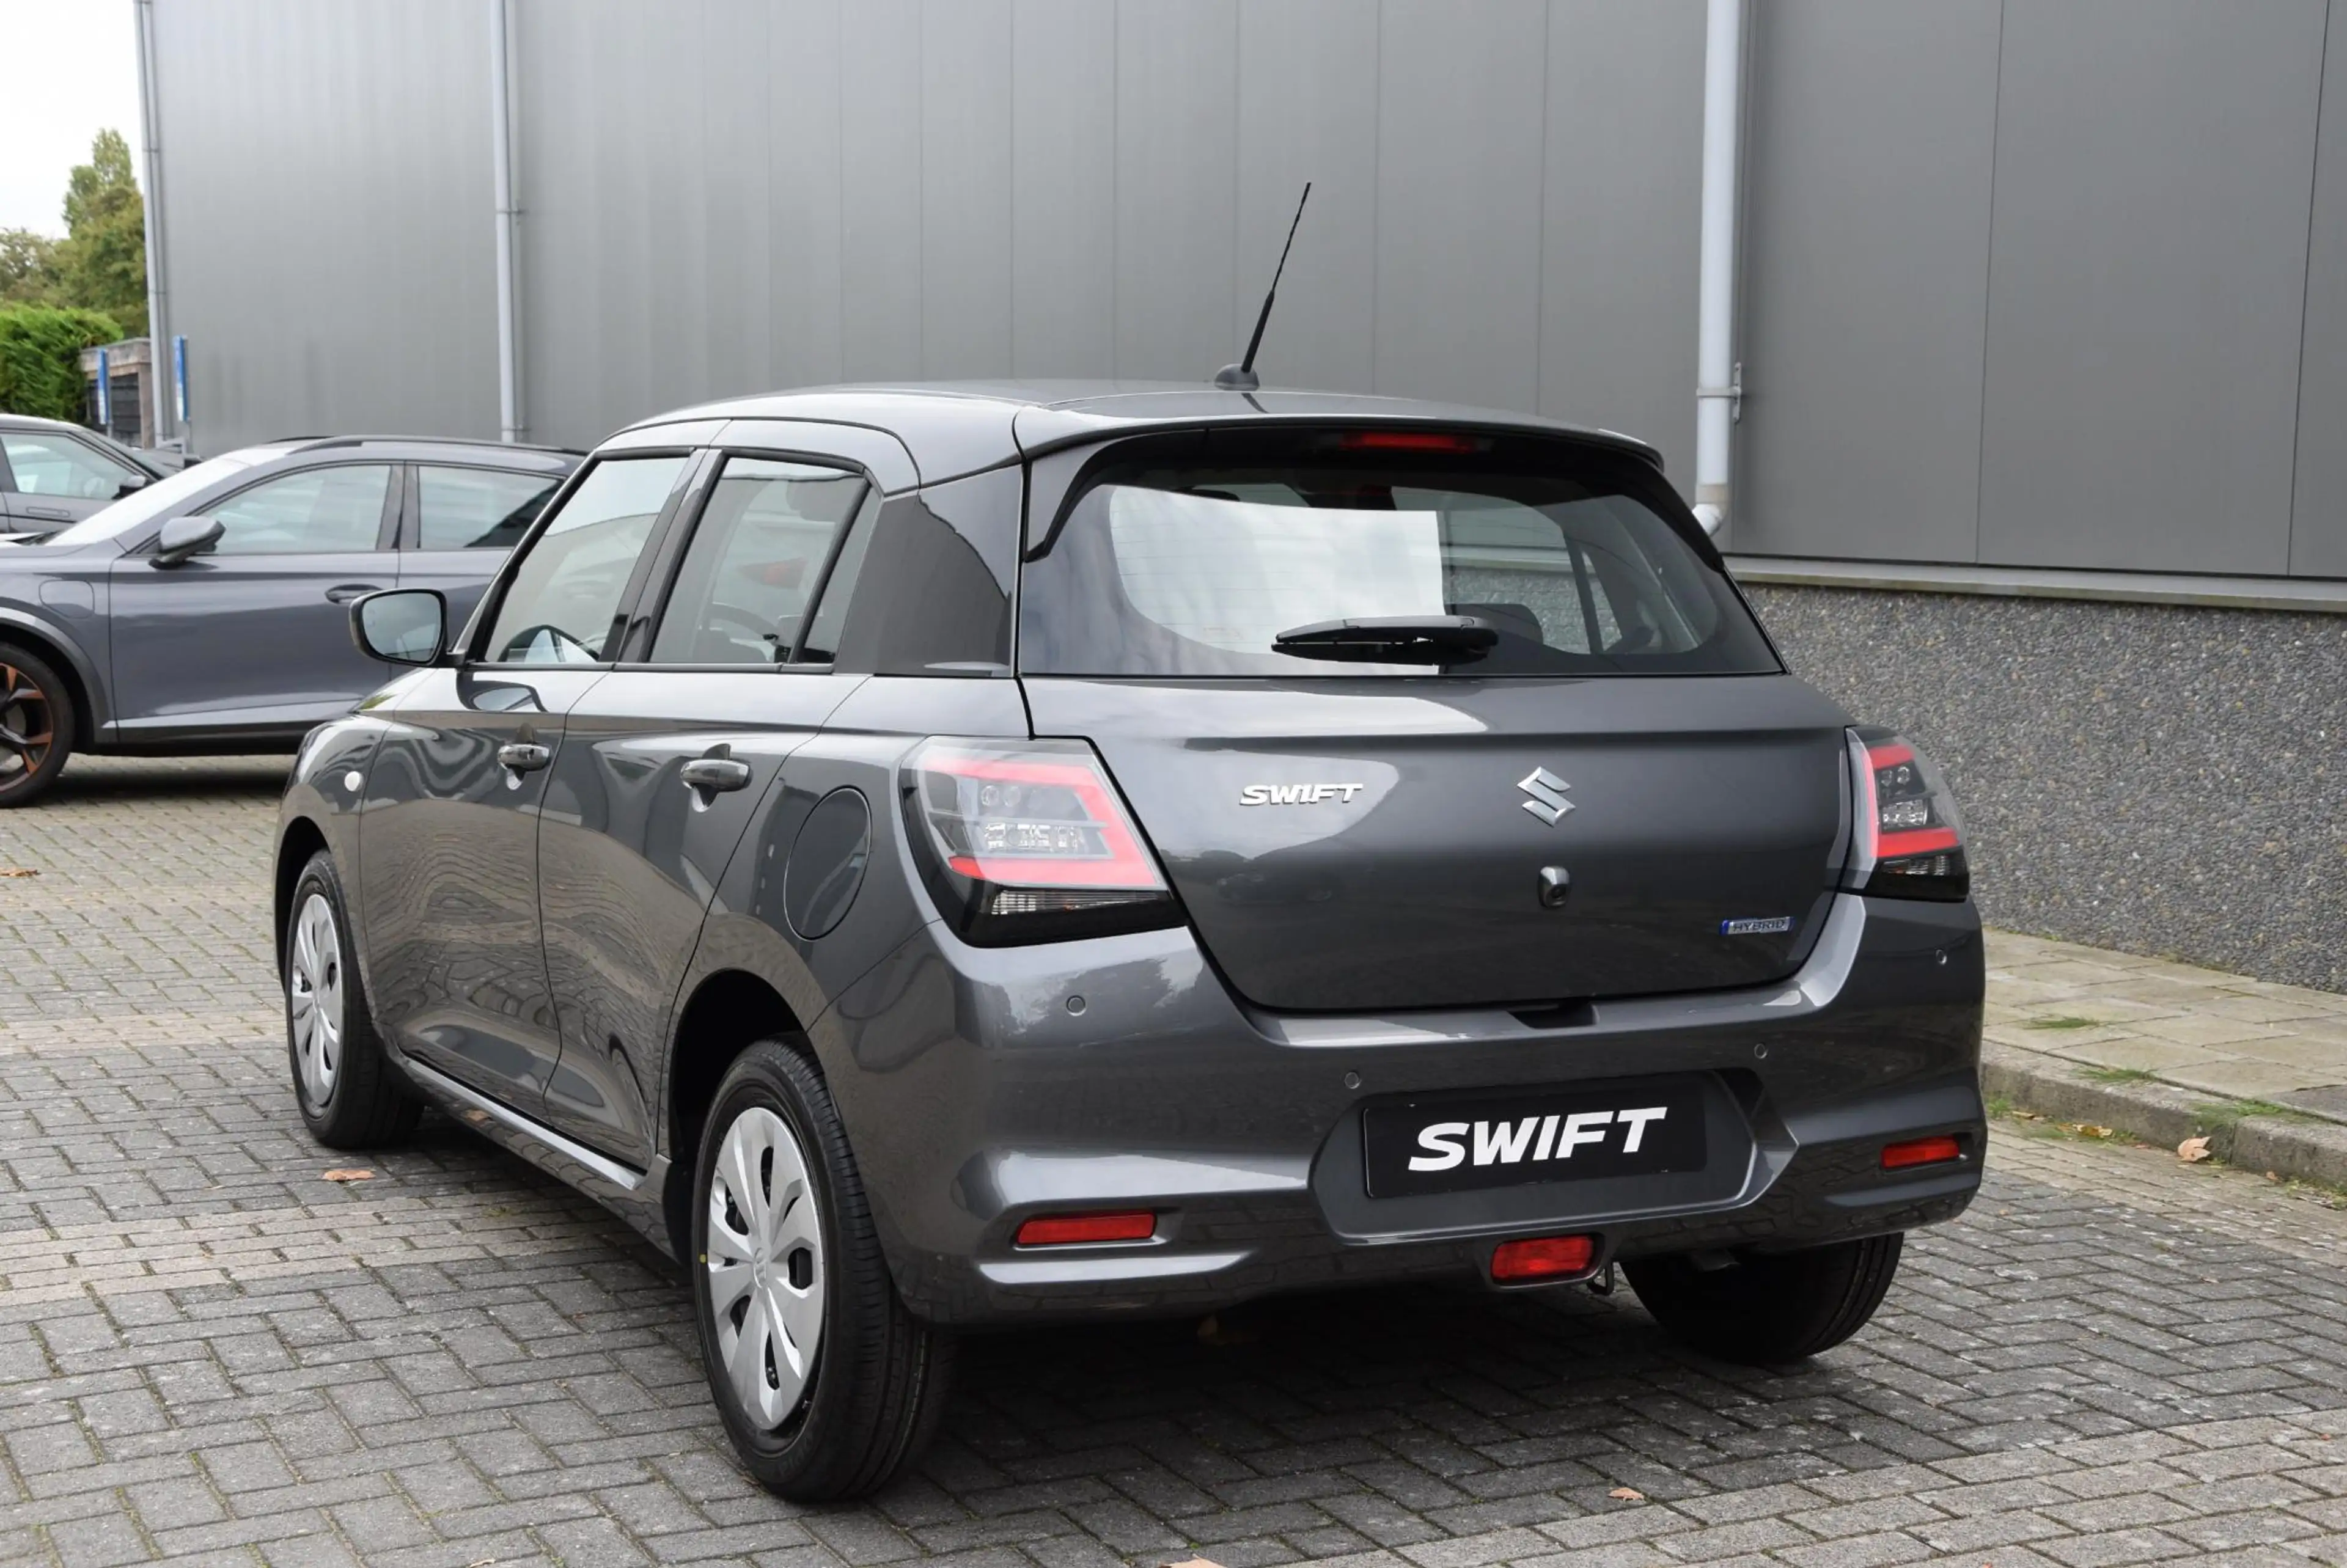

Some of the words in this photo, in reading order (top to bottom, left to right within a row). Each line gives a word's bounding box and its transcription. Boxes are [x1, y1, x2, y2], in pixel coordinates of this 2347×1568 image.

[1240, 783, 1364, 805] SWIFT
[1732, 918, 1785, 932] HYBRID
[1408, 1106, 1668, 1171] SWIFT
